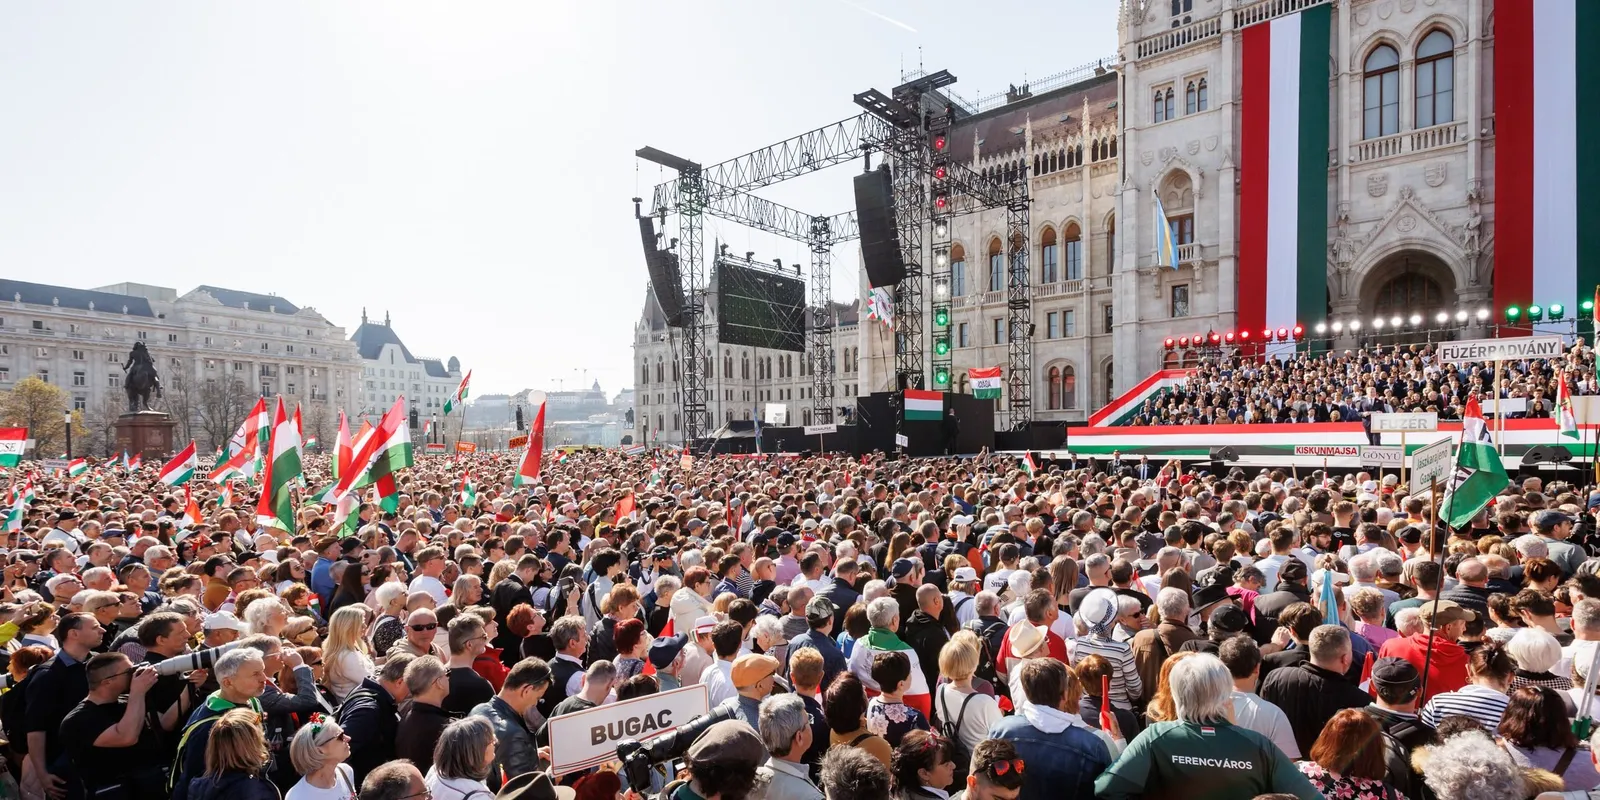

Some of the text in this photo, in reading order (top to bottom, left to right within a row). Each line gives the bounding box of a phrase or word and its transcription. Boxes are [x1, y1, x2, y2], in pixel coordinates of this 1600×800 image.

[1295, 446, 1358, 455] KISKUNMAJSA
[591, 709, 673, 746] BUGAC
[1171, 755, 1253, 770] FERENCVÁROS
